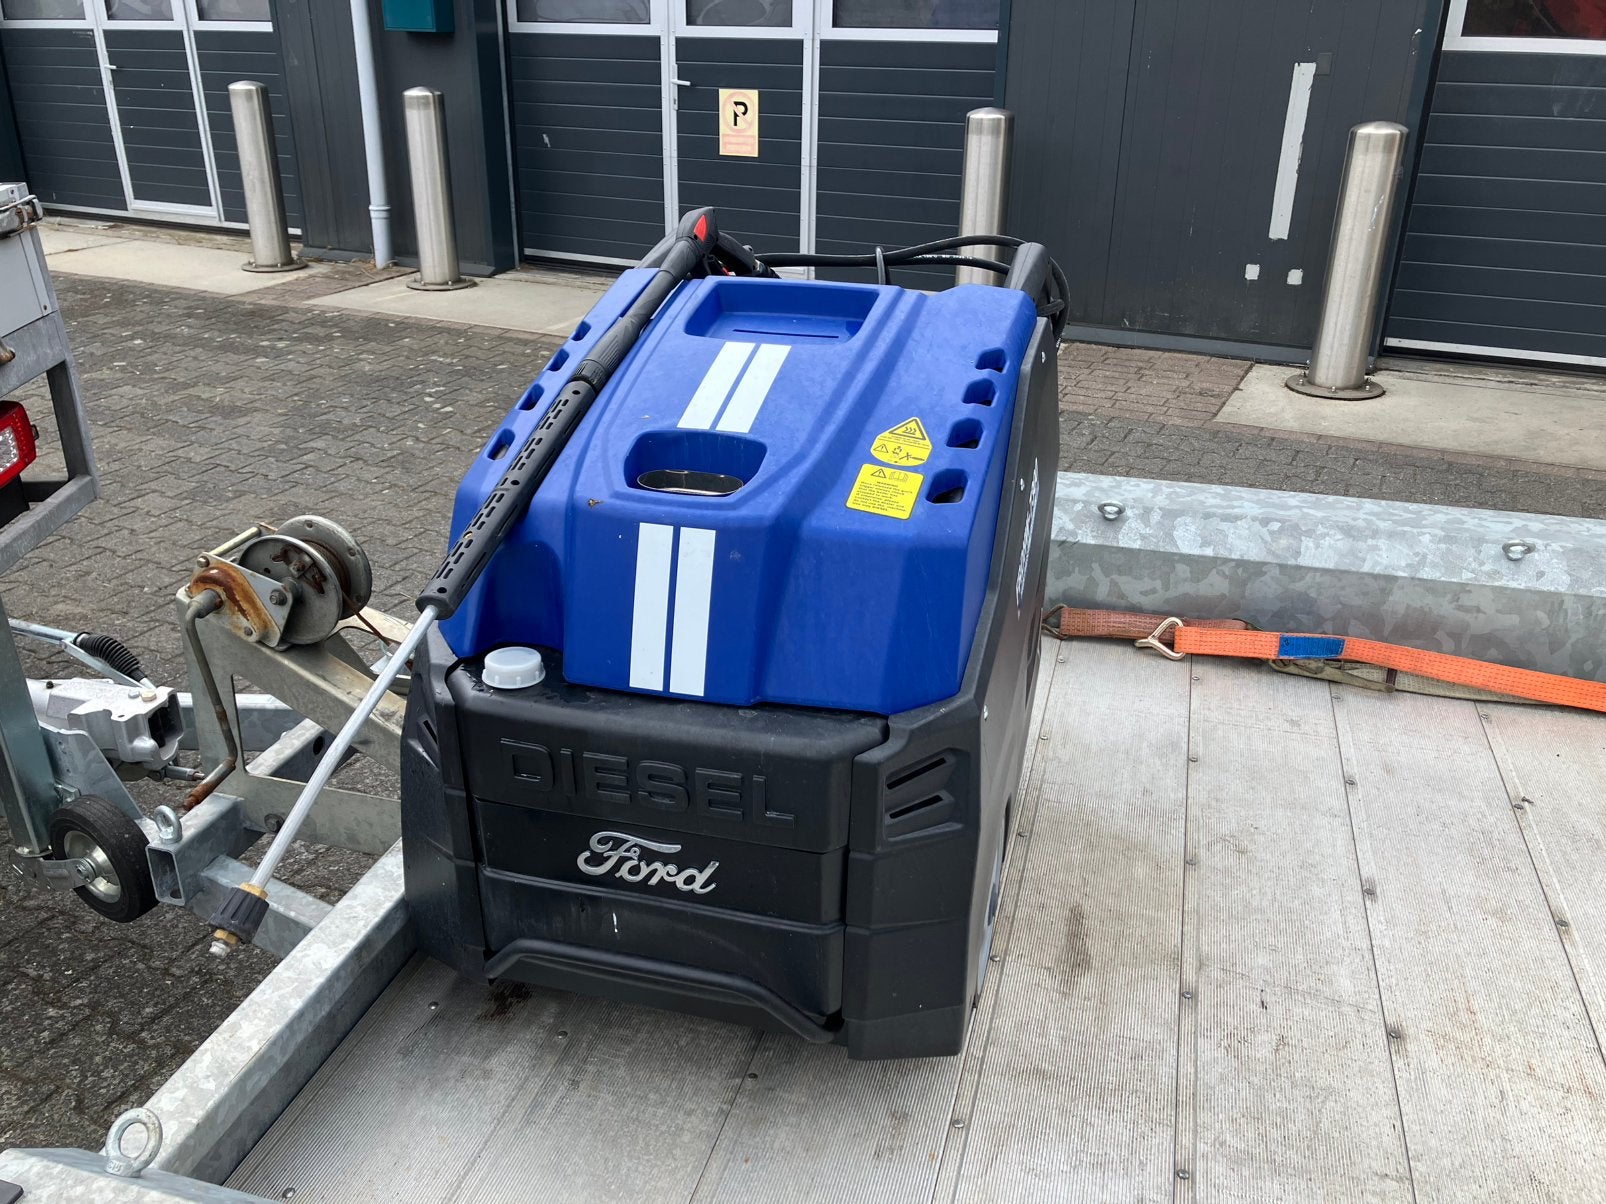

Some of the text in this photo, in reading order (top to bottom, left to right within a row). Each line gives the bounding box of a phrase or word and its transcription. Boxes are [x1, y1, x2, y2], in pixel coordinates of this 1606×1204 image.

[733, 101, 748, 126] P
[500, 737, 796, 829] DIESEL
[576, 831, 720, 894] Ford
